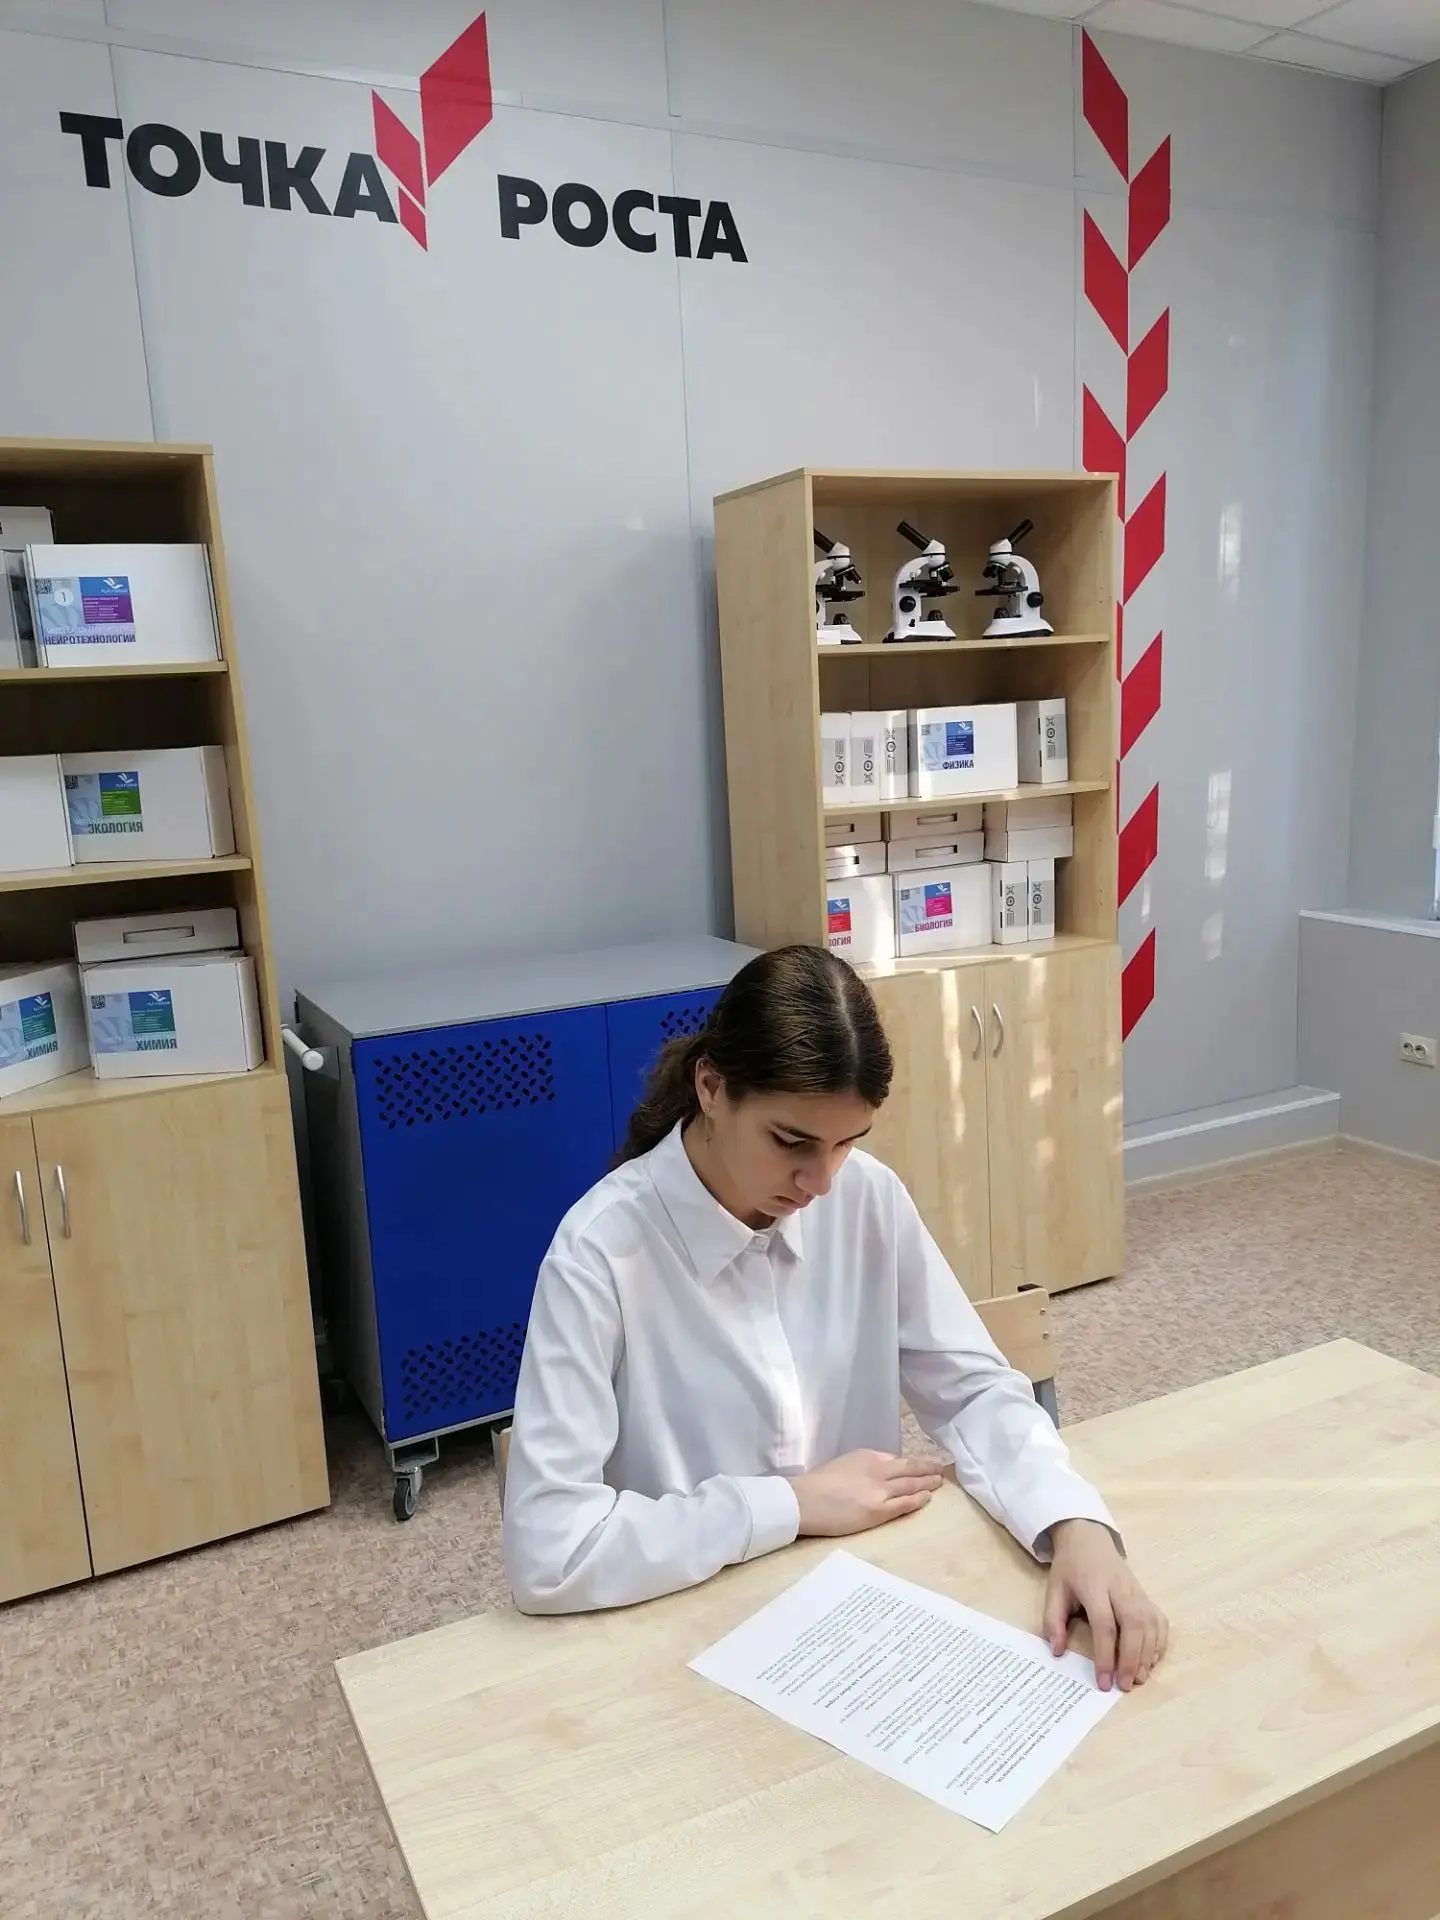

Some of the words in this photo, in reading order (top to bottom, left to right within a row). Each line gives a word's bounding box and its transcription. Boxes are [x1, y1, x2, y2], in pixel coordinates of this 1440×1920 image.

[60, 111, 399, 224] ТОЧКА
[497, 174, 749, 263] РОСТА
[45, 633, 136, 645] НЕЙРОТЕХНОЛОГИИ
[943, 759, 975, 769] ФИЗИКА
[88, 821, 143, 834] ЭКОЛОГИЯ
[915, 918, 953, 932] БИОЛОГИЯ
[27, 1041, 58, 1059] ХИМИЯ
[136, 1038, 178, 1051] ХИМИЯ
